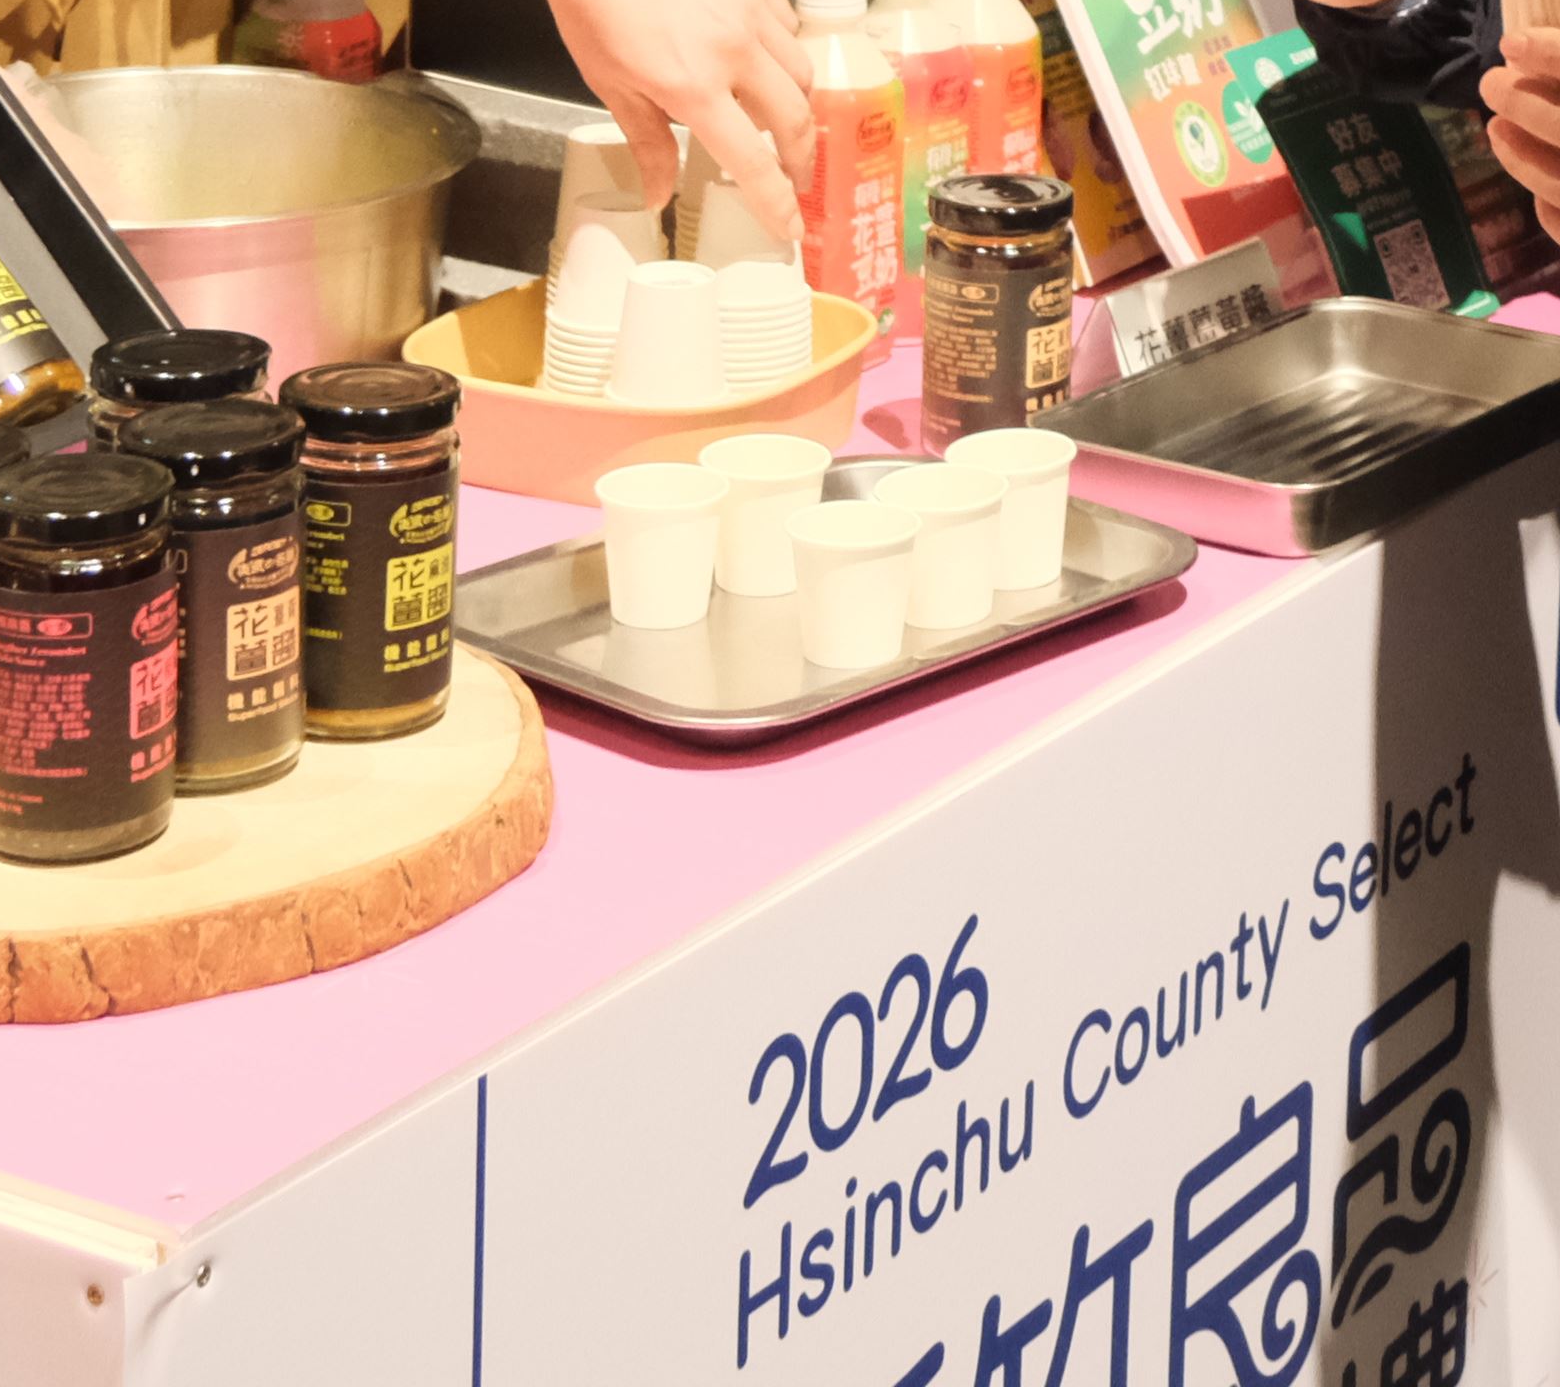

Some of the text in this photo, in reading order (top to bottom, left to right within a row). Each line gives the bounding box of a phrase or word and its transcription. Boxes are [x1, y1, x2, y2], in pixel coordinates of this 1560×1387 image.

[737, 753, 1476, 1369] Hsinchu County Select
[744, 914, 988, 1209] 2026
